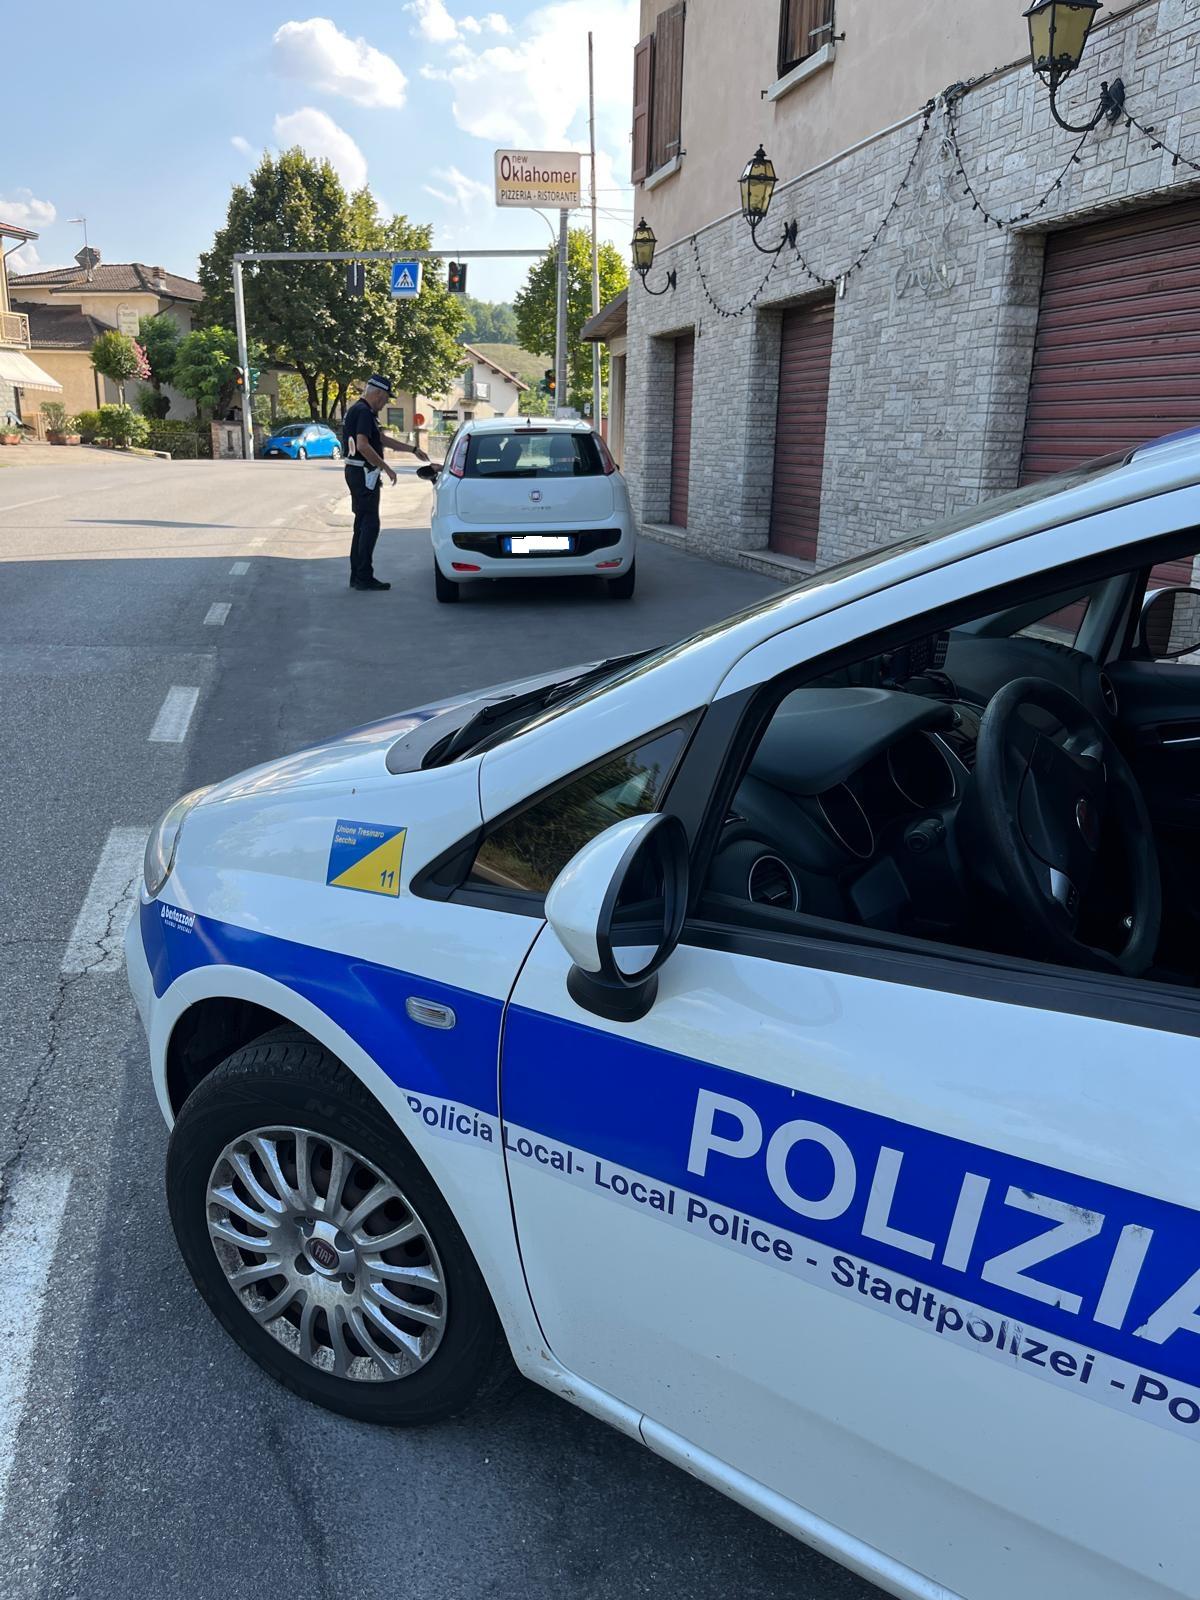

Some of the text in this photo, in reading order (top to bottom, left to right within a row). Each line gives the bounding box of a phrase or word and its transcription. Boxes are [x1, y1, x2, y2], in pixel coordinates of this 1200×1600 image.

[512, 155, 528, 163] new
[500, 155, 577, 184] Oklahomer
[500, 190, 533, 201] PIZZERIA
[537, 191, 578, 202] RISTORANTE
[380, 869, 395, 889] 11
[314, 1244, 334, 1264] FIAT
[594, 1161, 675, 1215] Local
[686, 1198, 793, 1262] Police
[830, 1255, 1096, 1384] Stadtpolizei
